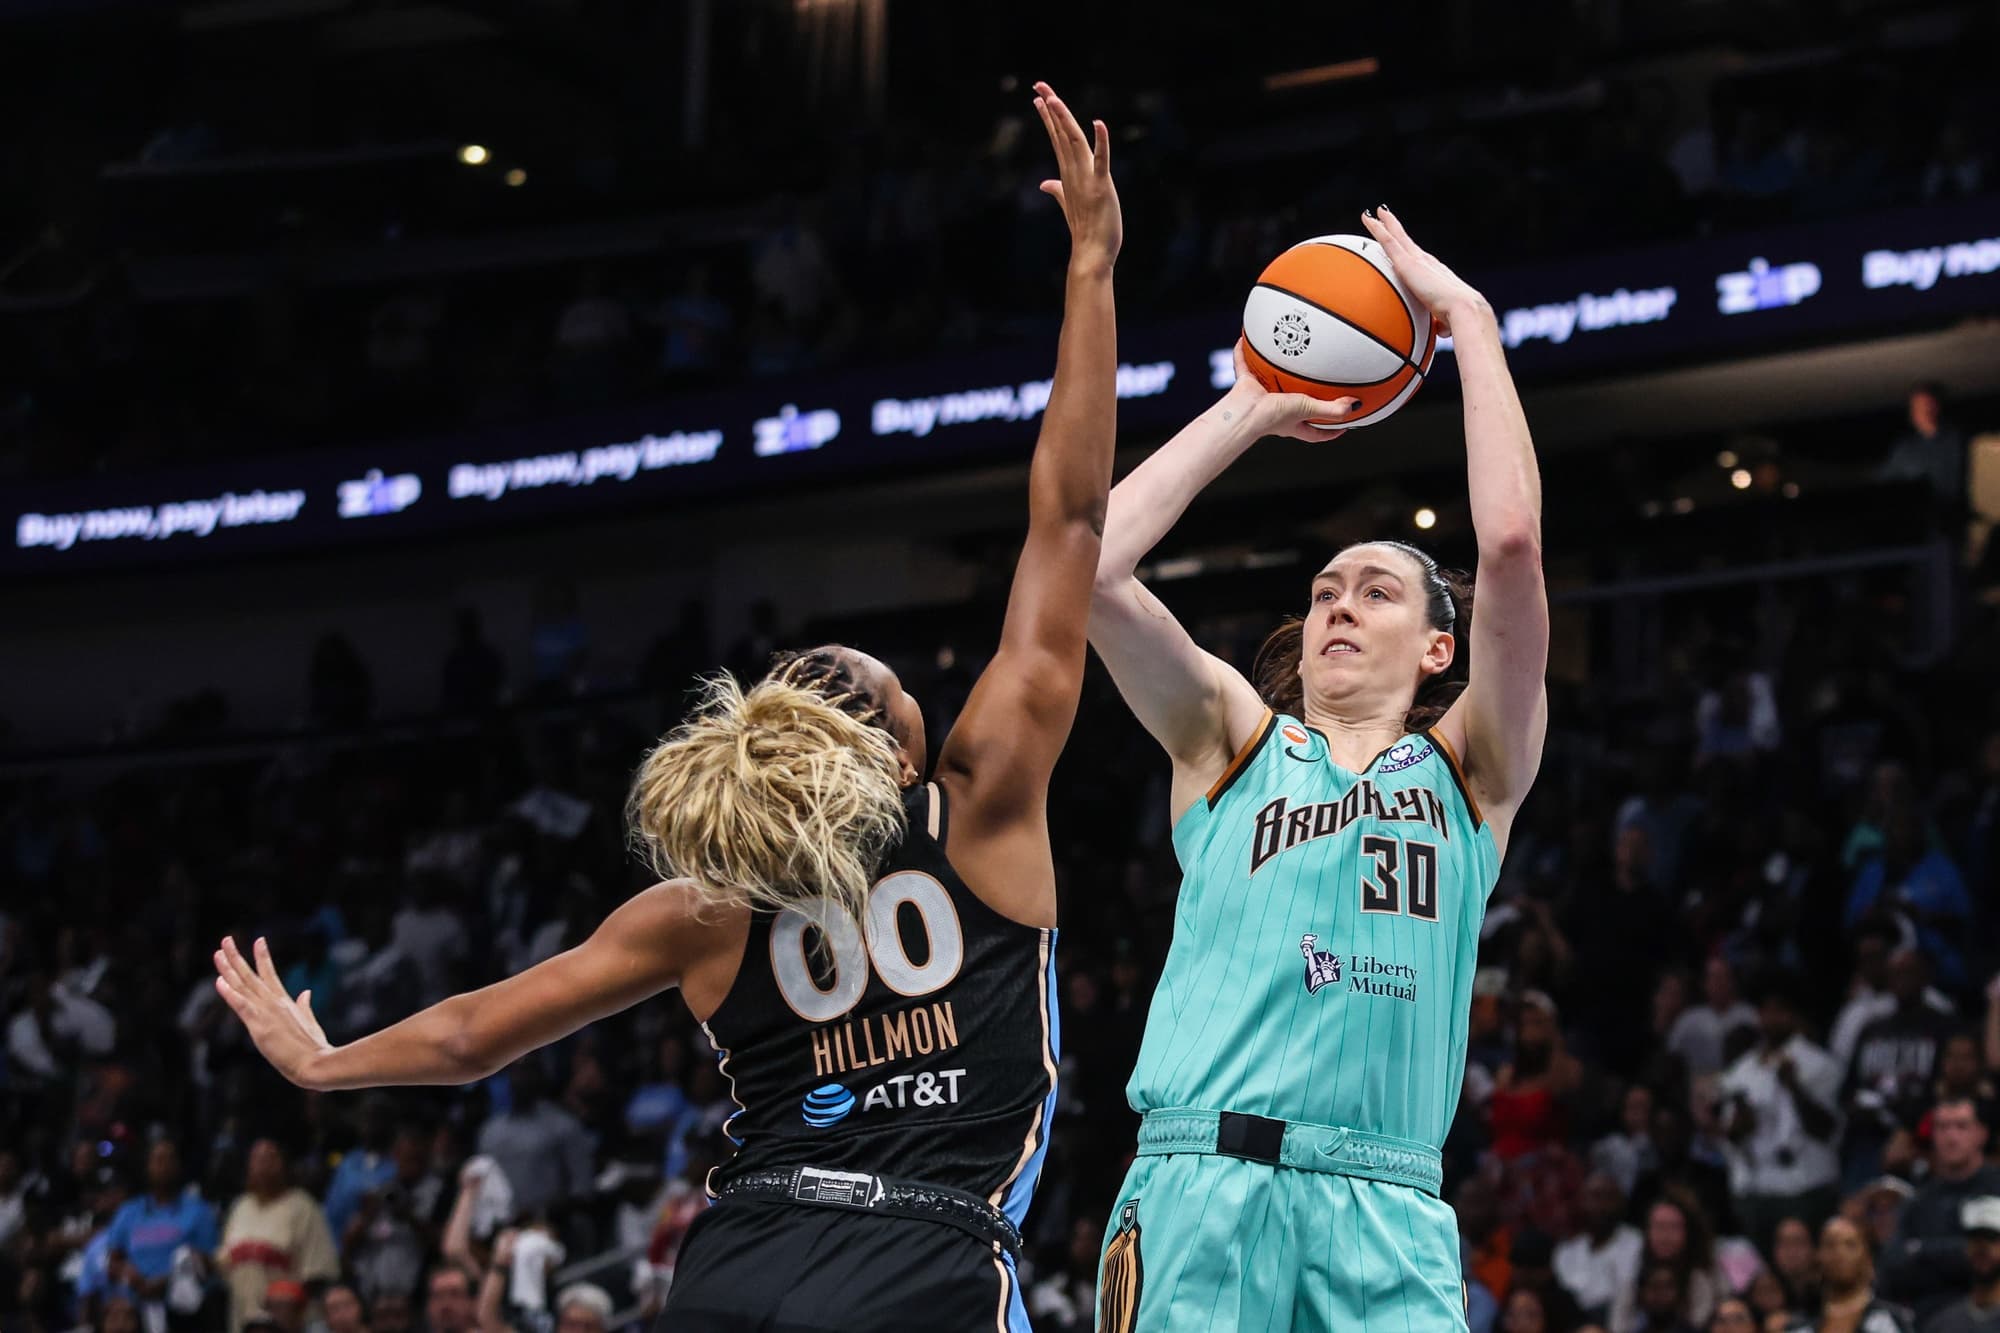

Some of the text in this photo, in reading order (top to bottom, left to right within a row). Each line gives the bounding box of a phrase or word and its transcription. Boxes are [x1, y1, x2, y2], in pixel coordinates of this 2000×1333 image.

[1863, 238, 2000, 290] Buy no
[1503, 287, 1677, 349] pay later
[1116, 362, 1175, 398] ter
[872, 397, 938, 437] Buy
[448, 461, 511, 501] Buy
[582, 441, 641, 484] pay
[640, 430, 723, 469] later
[16, 512, 82, 550] Buy
[157, 499, 223, 539] pay
[220, 489, 306, 527] later
[1379, 746, 1431, 772] BARCLAYS
[1249, 780, 1449, 879] BROOKLYN
[1360, 835, 1440, 922] 30
[769, 870, 963, 1022] 00
[1351, 955, 1417, 986] Liberty
[1349, 976, 1417, 1002] Mutual
[811, 1001, 959, 1077] HILLMON
[862, 1068, 967, 1112] AT&T
